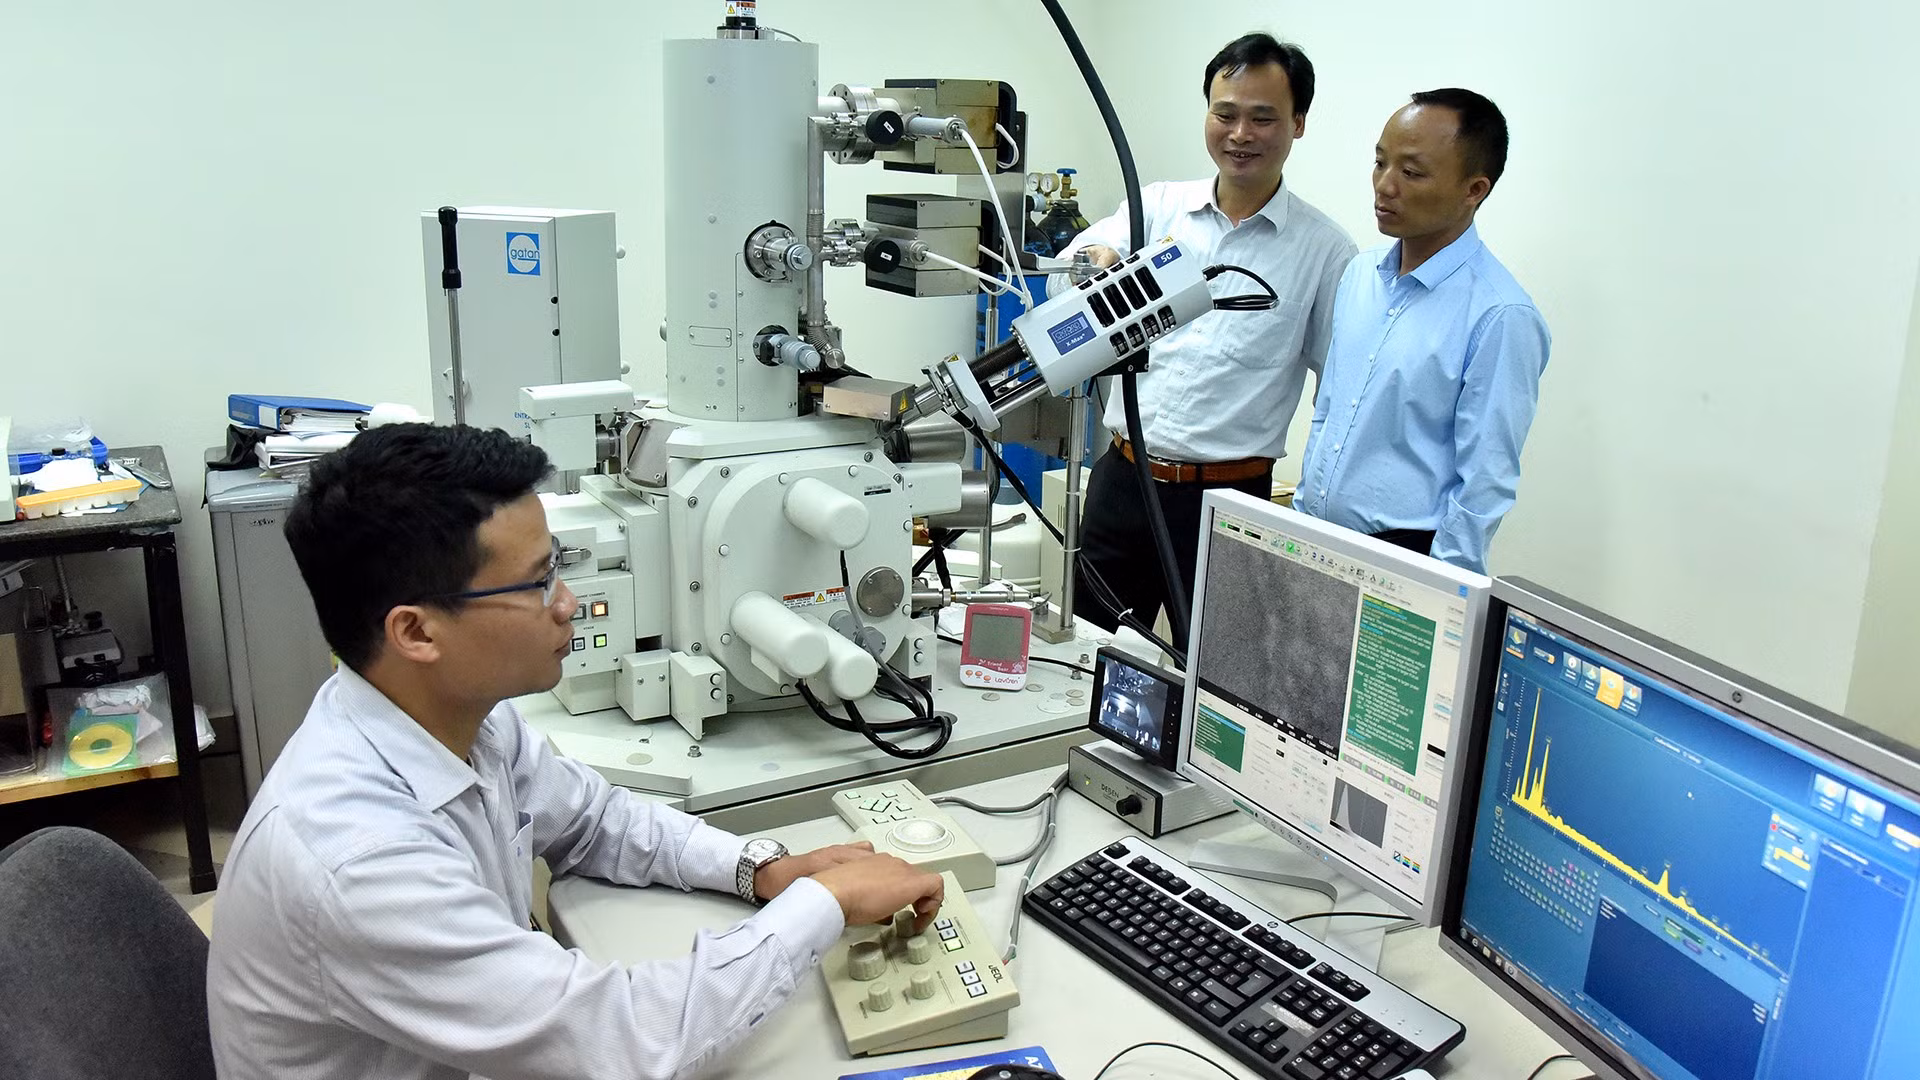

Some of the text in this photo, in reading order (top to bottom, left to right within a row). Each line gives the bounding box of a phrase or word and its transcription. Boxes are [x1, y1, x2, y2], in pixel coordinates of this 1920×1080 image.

[510, 248, 540, 260] gatan
[1160, 252, 1173, 263] 50
[988, 964, 1003, 983] JEOL
